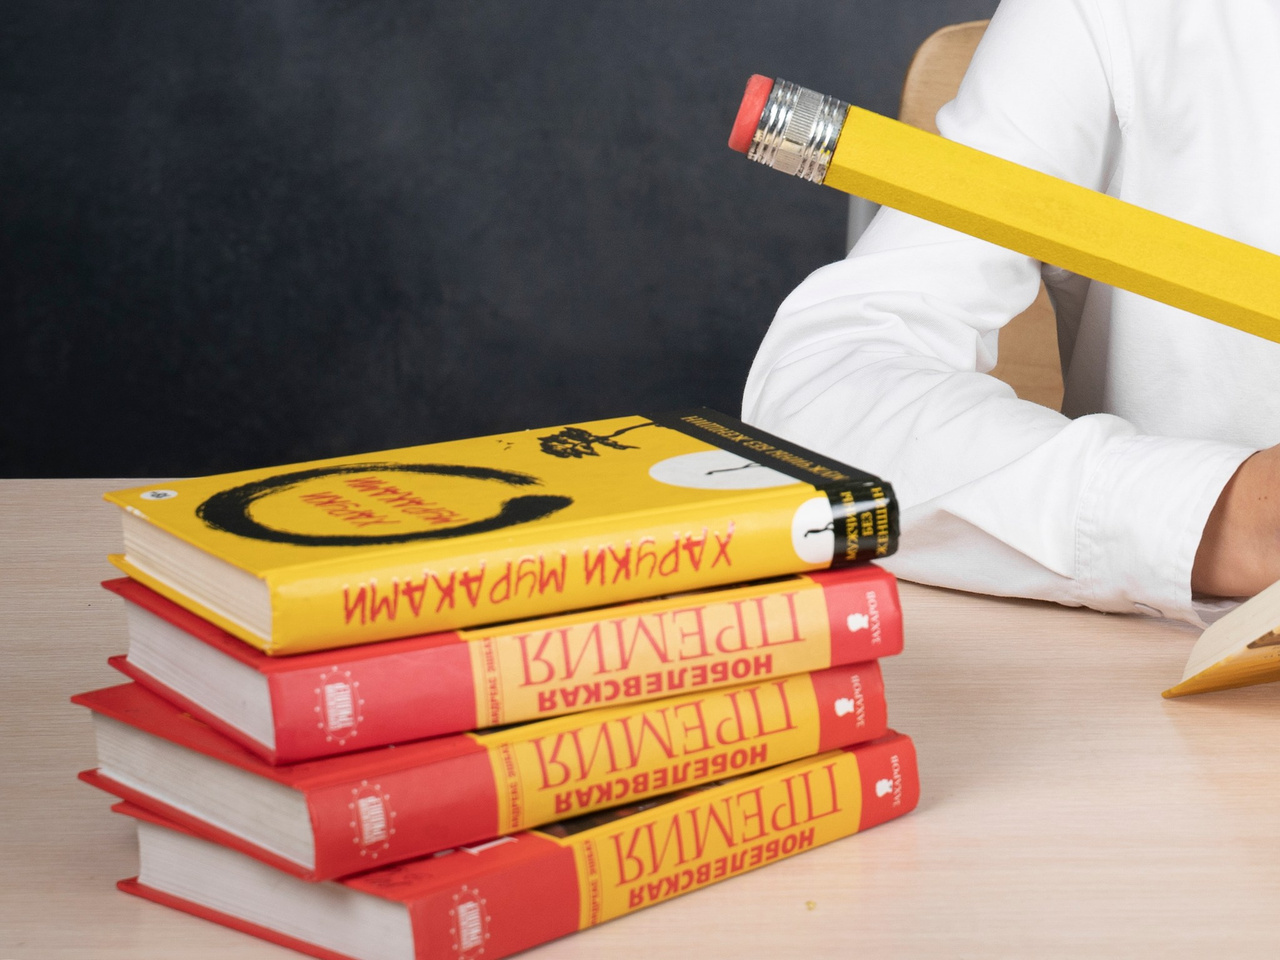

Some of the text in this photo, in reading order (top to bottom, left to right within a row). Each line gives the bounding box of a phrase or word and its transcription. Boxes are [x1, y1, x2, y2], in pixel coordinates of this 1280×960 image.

[861, 511, 874, 537] БЕЗ
[342, 521, 736, 625] ХАРУКИ МУРАКАМИ
[513, 592, 805, 687] ПРЕМИЯ
[866, 591, 881, 644] ЗАХАРОВ
[538, 653, 773, 712] НОБЕЛЕВСКАЯ
[851, 675, 865, 727] ЗАХАРОВ
[529, 681, 798, 791] ПРЕМИЯ
[554, 743, 767, 814] НОБЕЛЕВСКАЯ
[890, 755, 903, 807] ЗАХАРОВ
[610, 762, 842, 887] ПРЕМИЯ
[629, 827, 815, 908] НОБЕЛЕВСКАЯ
